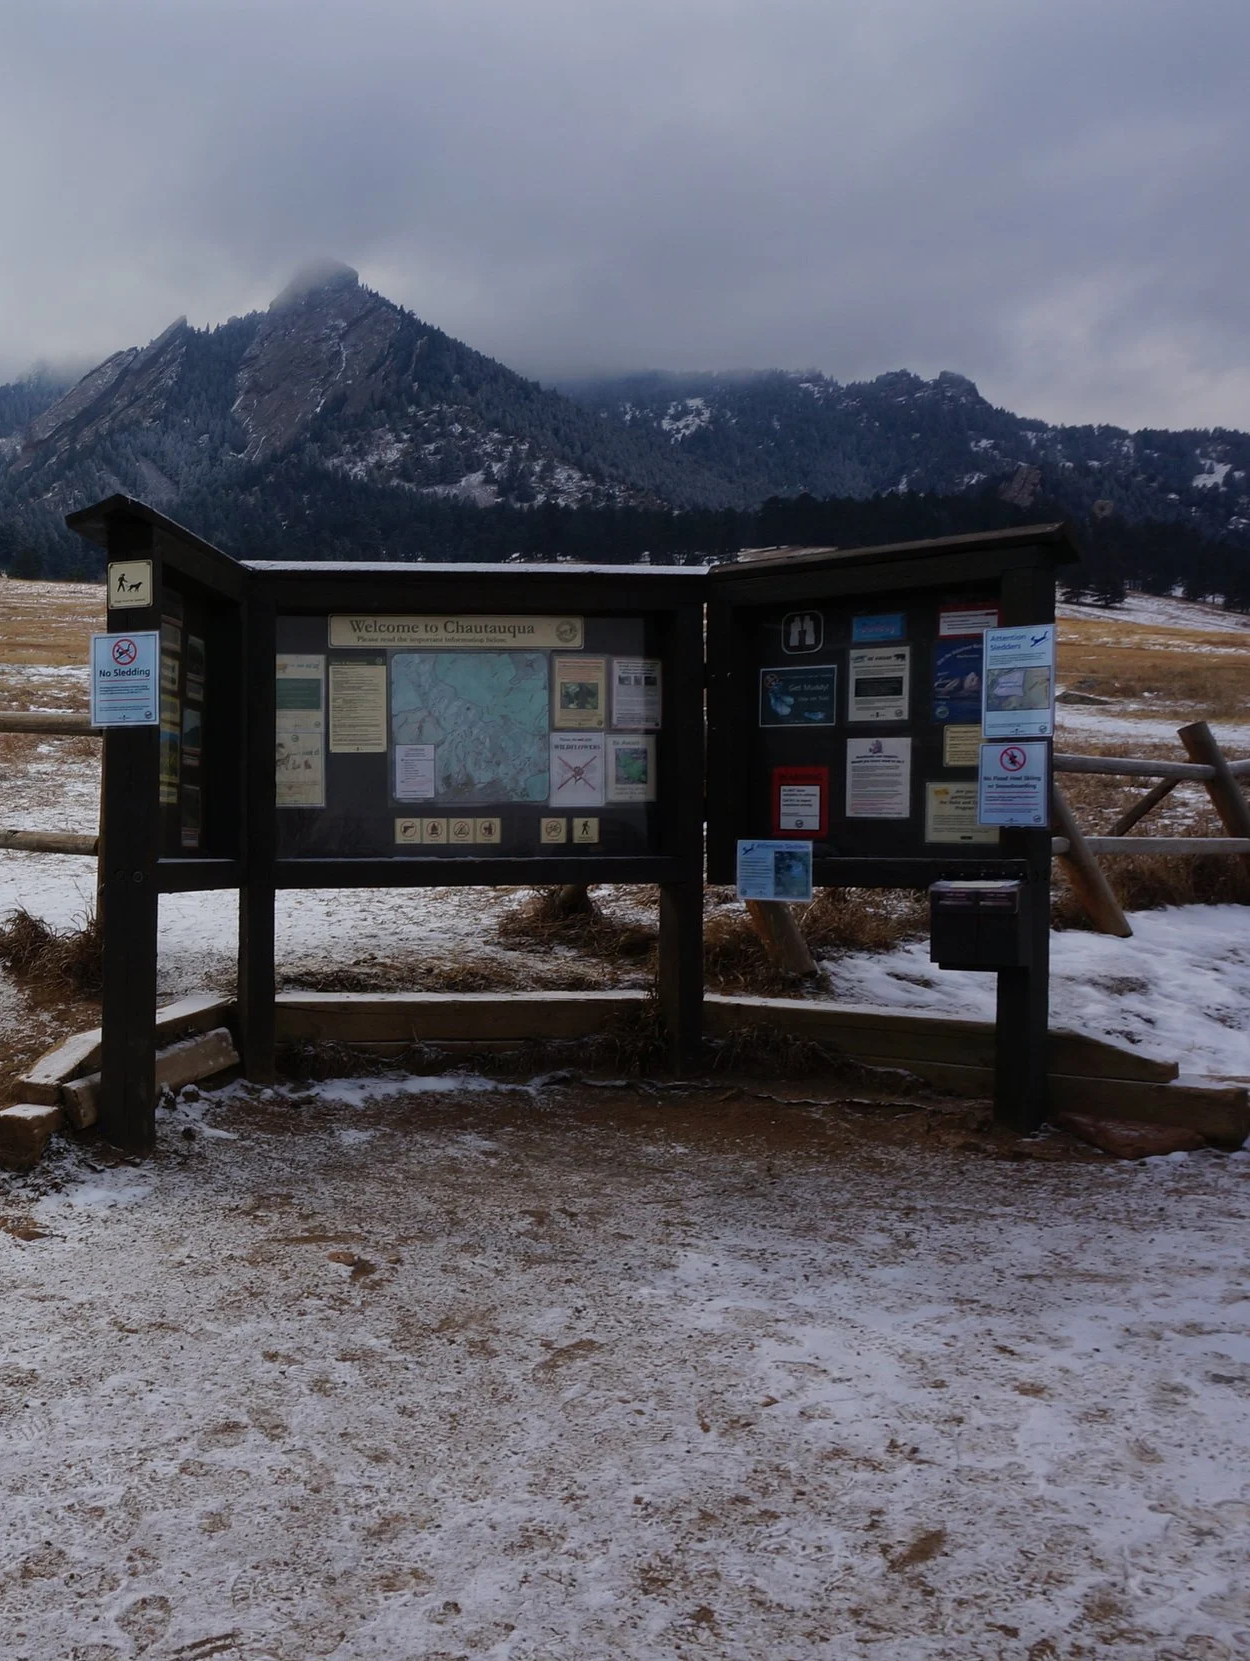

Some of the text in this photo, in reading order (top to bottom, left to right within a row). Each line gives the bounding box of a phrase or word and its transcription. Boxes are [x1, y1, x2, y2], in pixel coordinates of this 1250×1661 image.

[349, 619, 535, 637] Welcome to Chautauqua
[410, 636, 443, 644] important
[990, 634, 1027, 642] Attention
[990, 643, 1021, 652] Sledders
[99, 667, 151, 678] No Sledding
